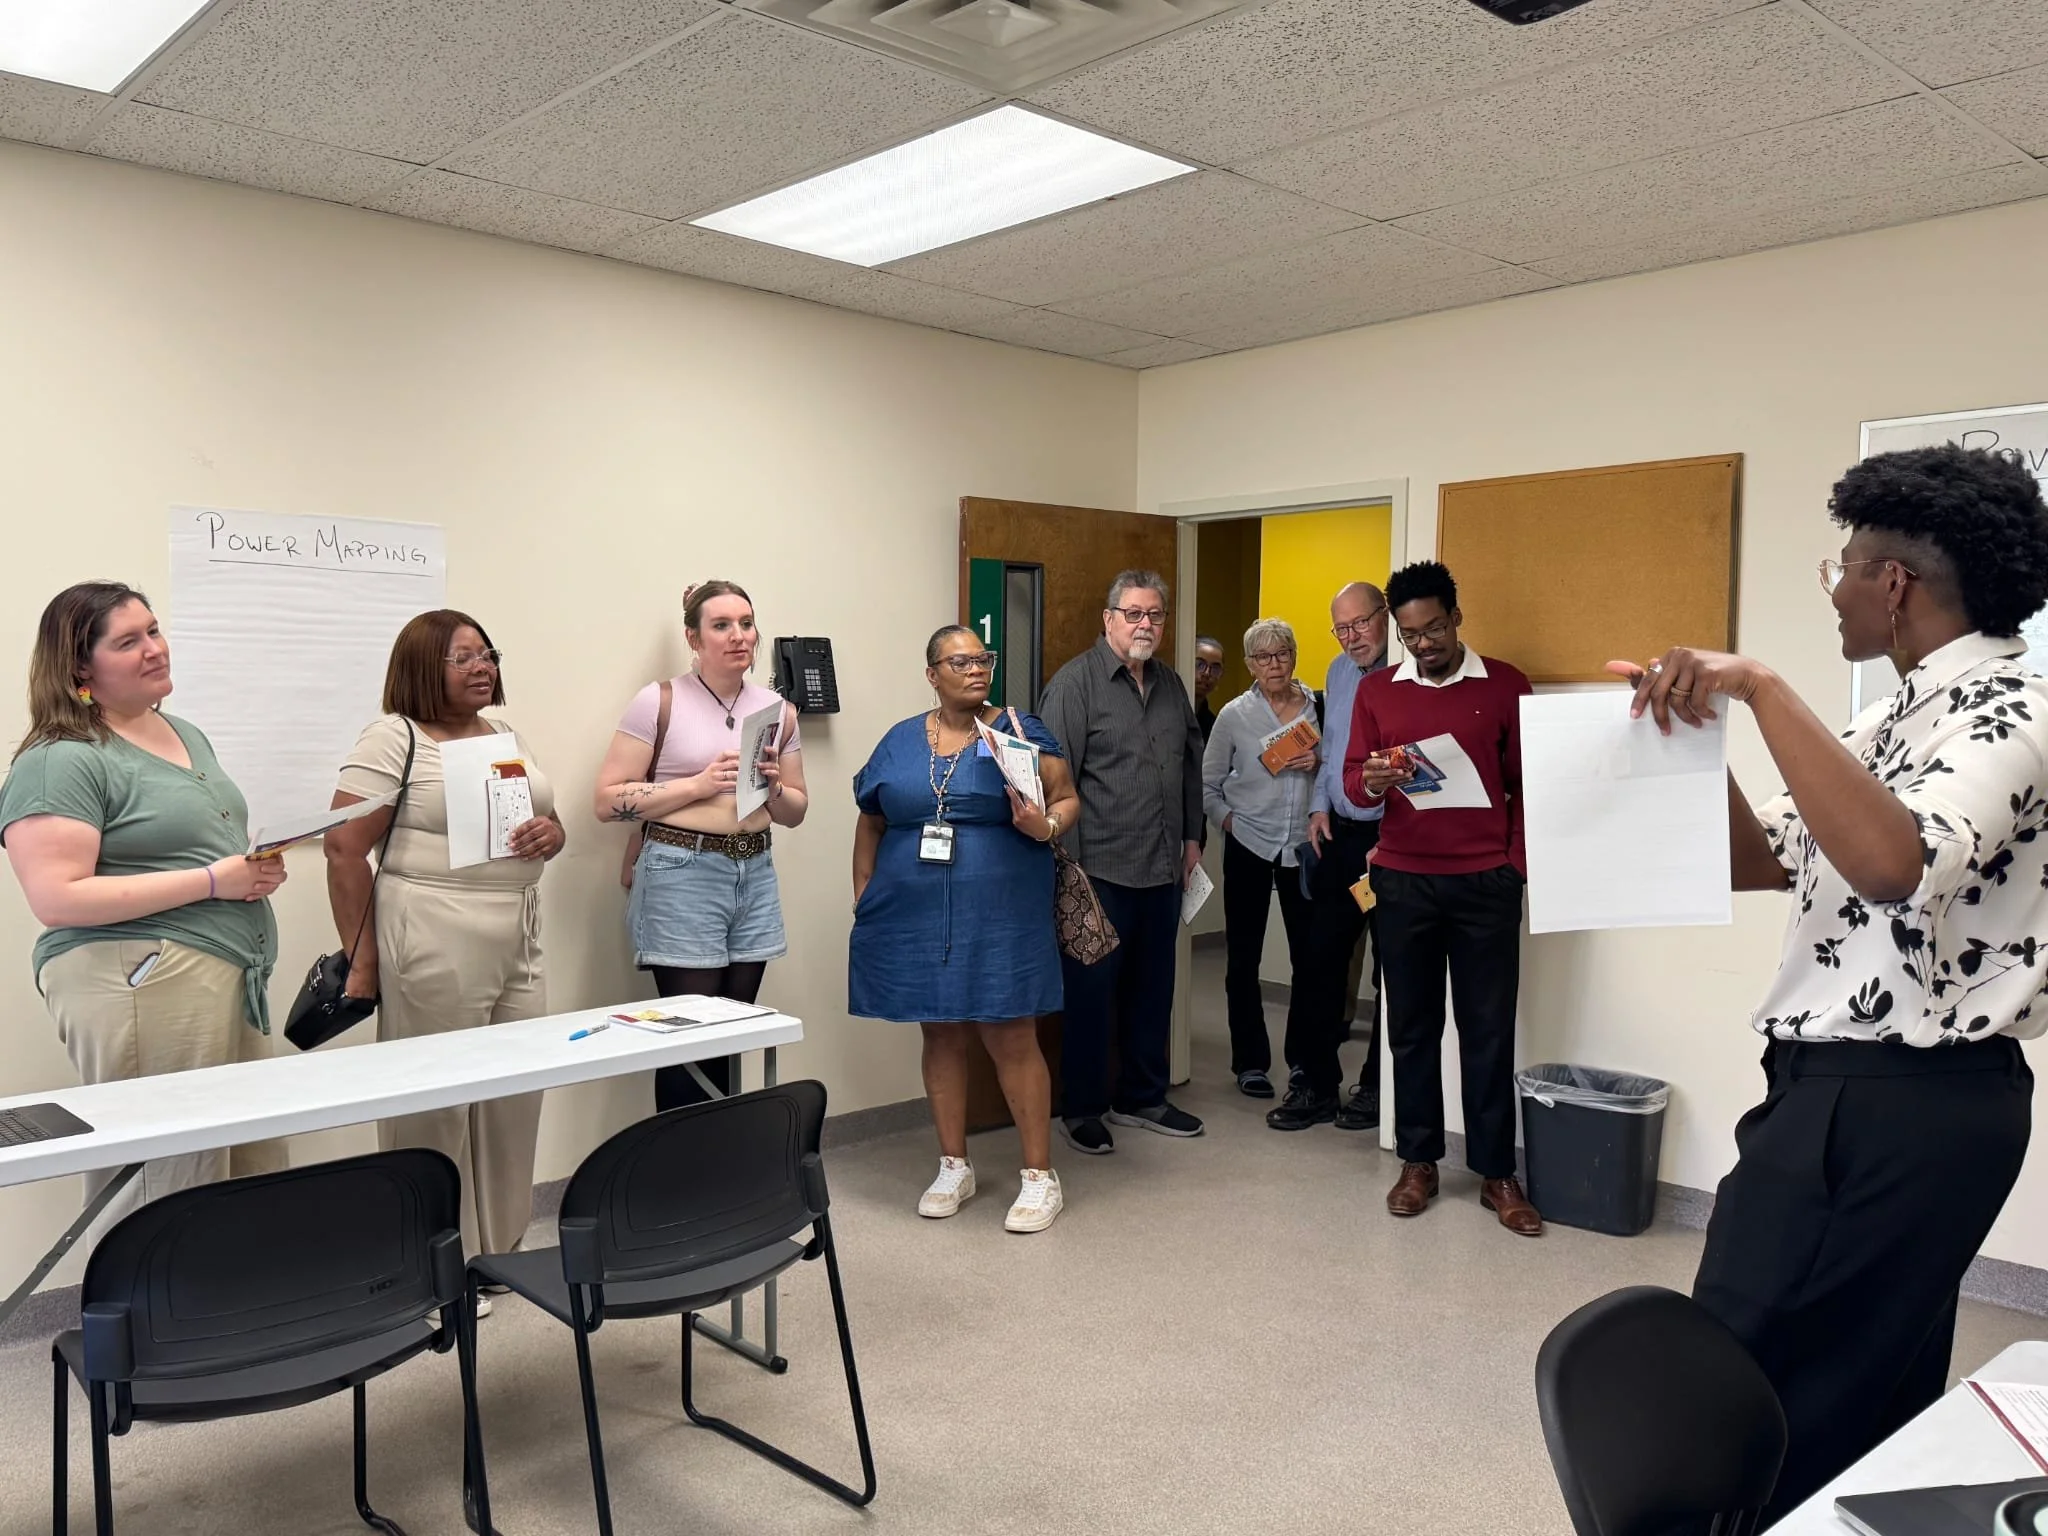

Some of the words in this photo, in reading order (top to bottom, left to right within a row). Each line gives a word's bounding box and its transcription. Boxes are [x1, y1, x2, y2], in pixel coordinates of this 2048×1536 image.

[196, 511, 302, 558] POWER
[315, 524, 427, 564] MAPPING
[979, 614, 991, 645] 1
